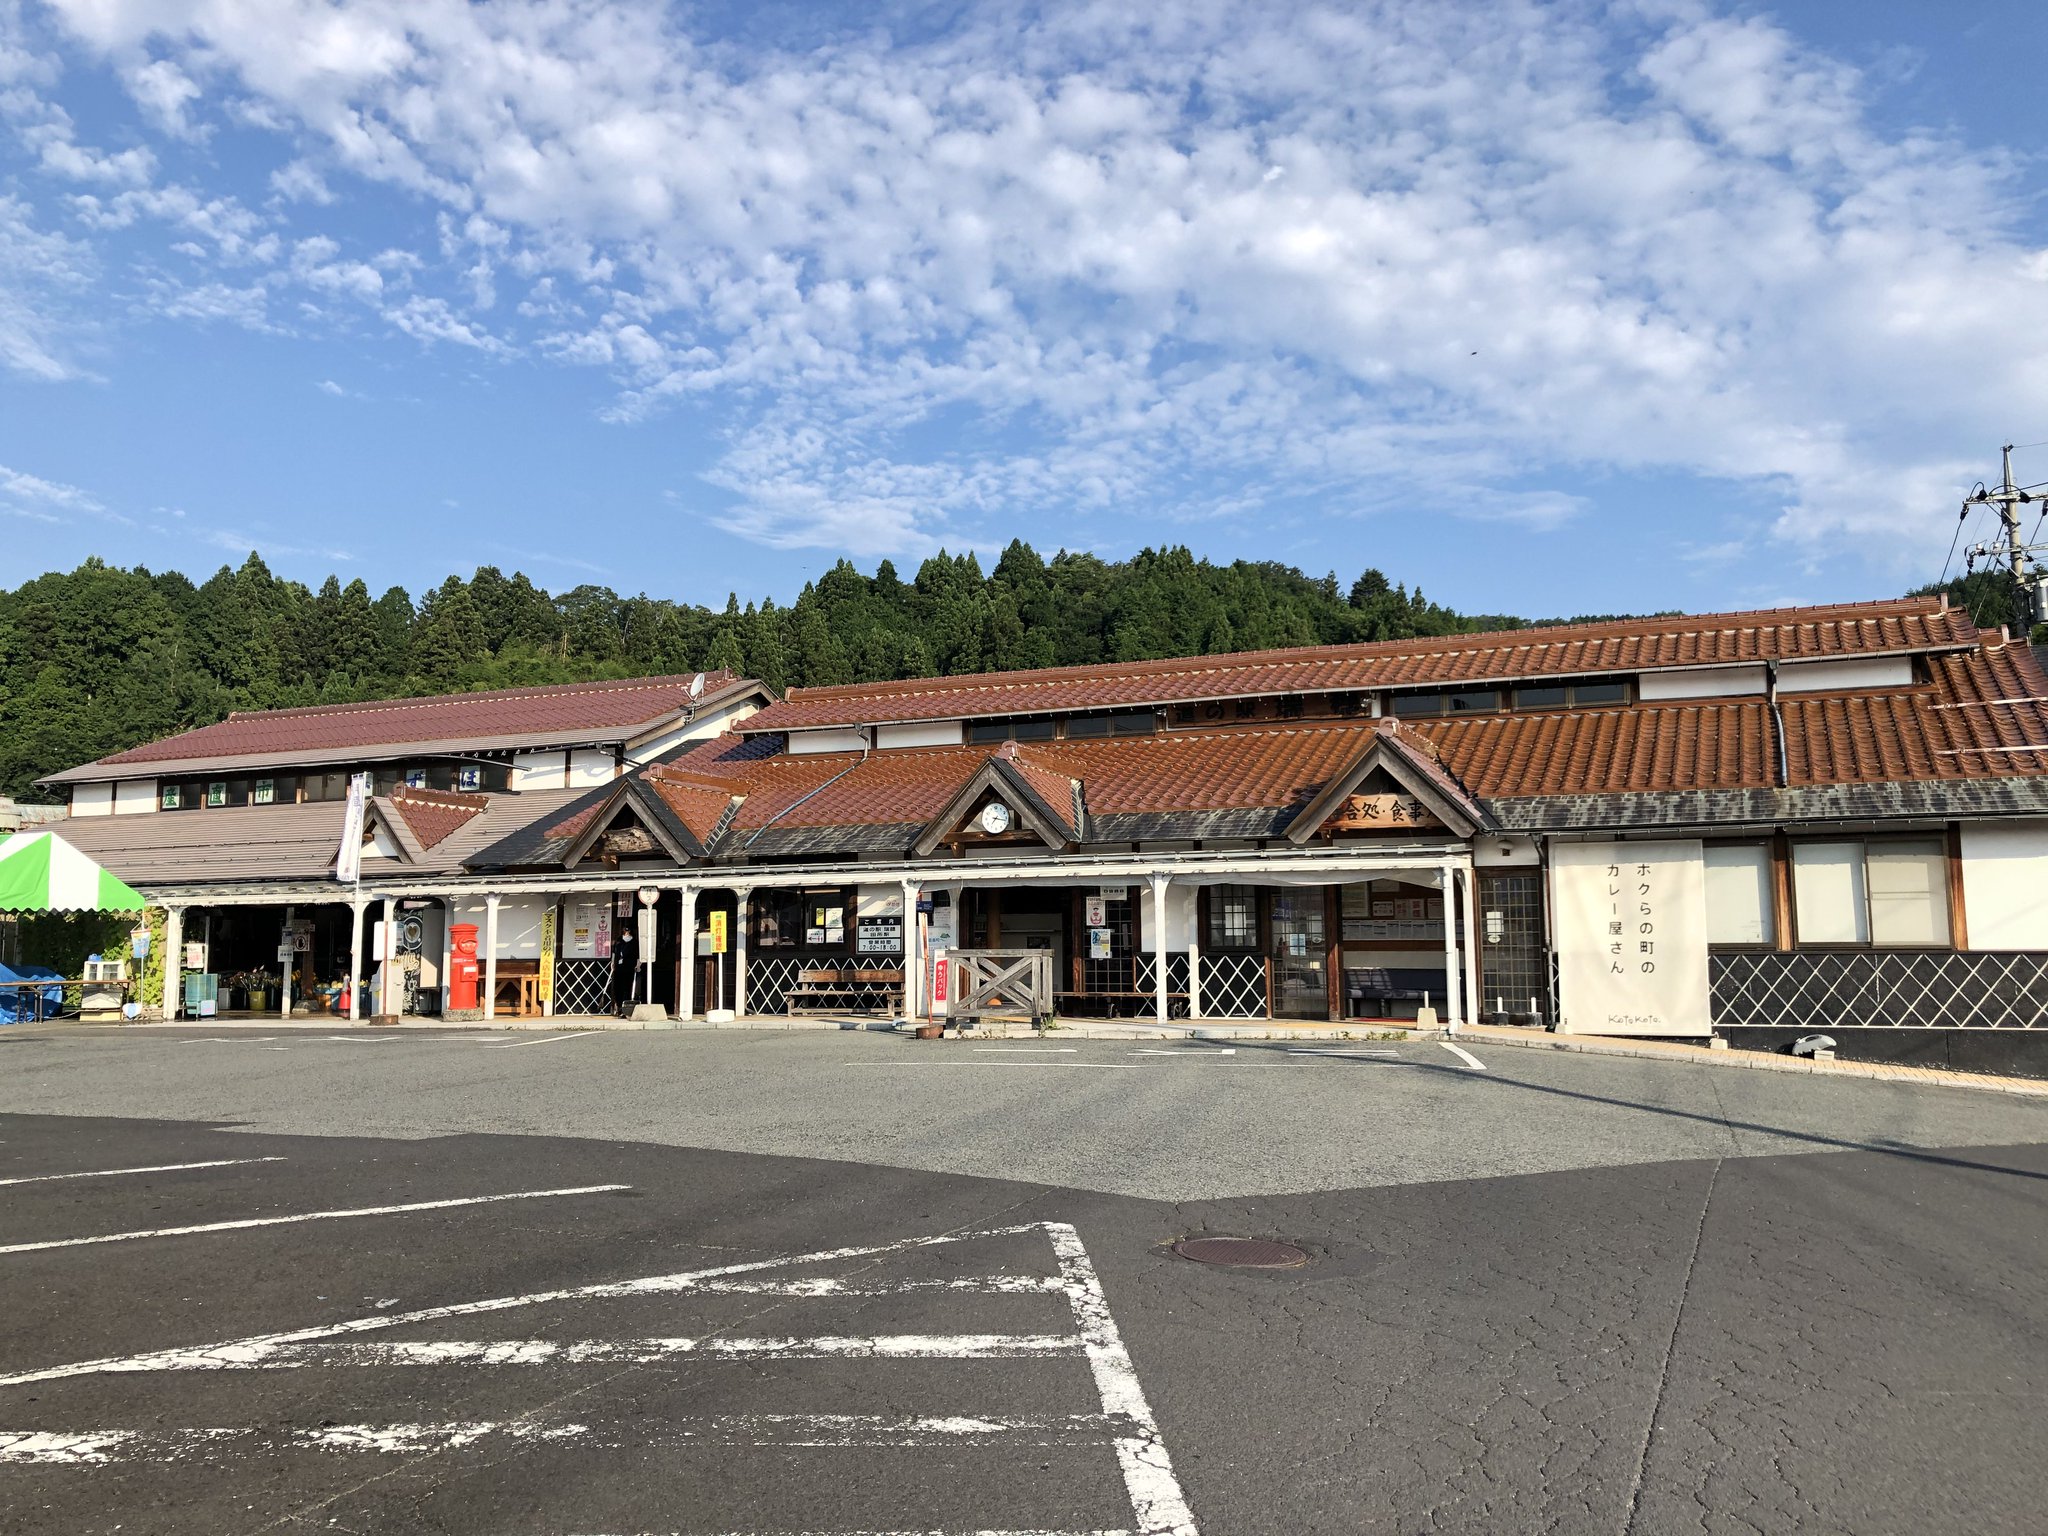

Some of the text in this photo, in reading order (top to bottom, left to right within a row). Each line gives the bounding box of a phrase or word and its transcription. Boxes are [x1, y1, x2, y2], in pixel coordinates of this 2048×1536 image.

[1607, 864, 1624, 974] カレー屋さん
[1637, 864, 1655, 974] ホクらの町の
